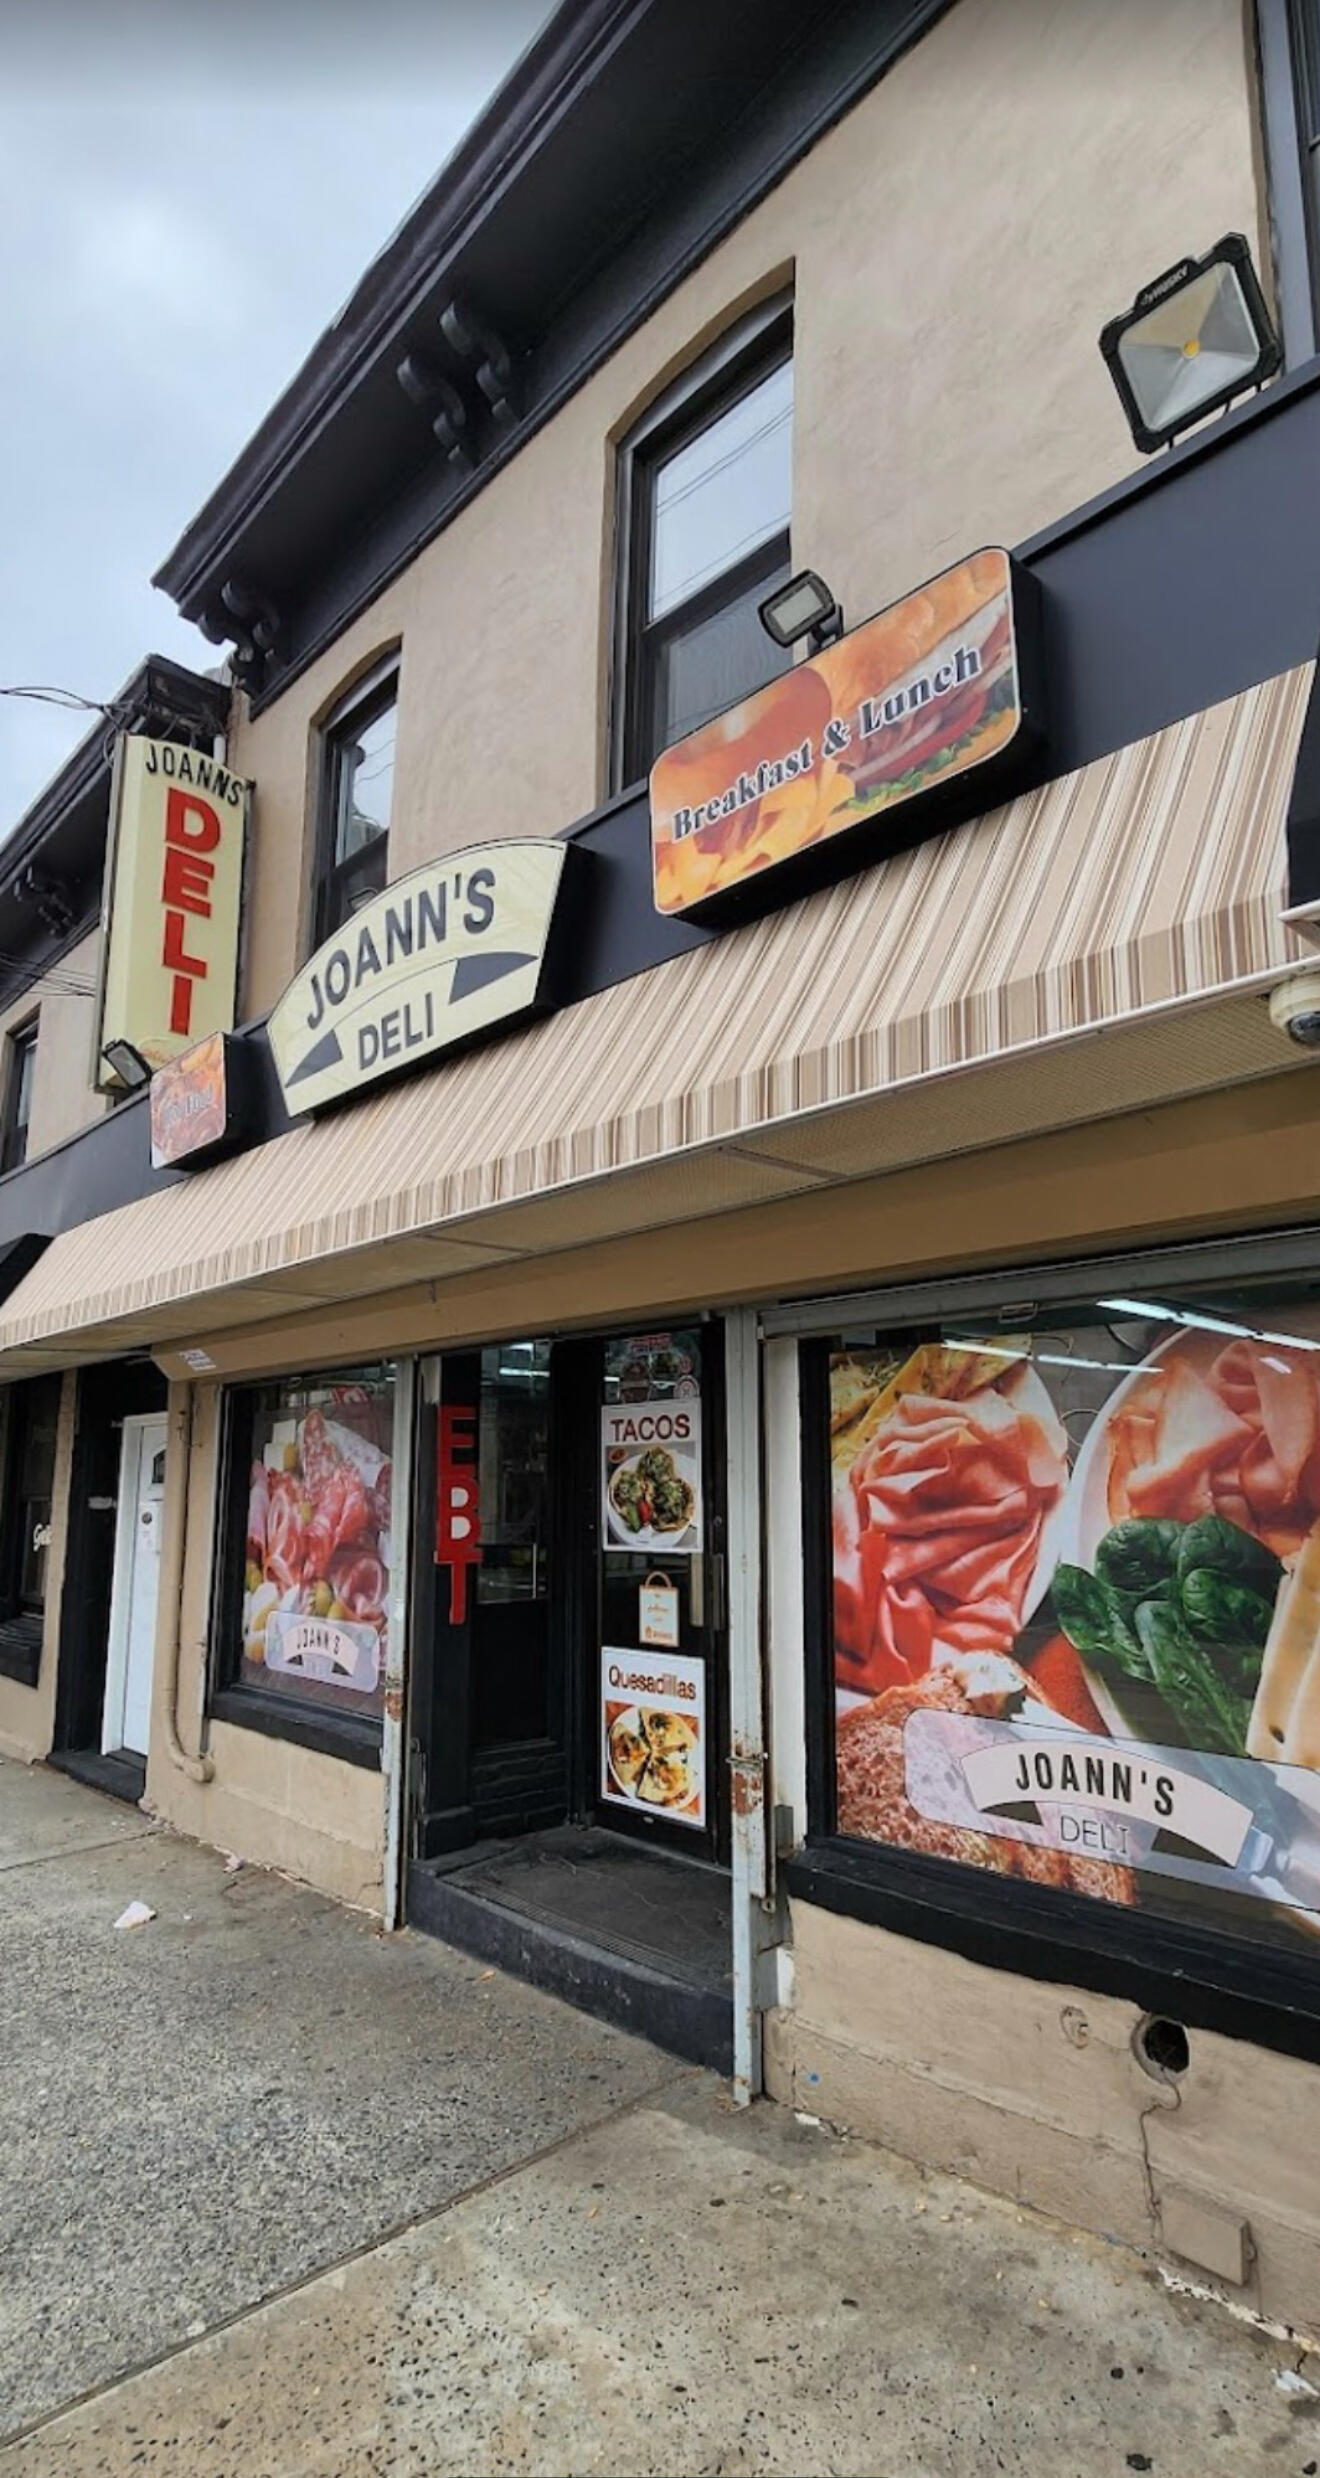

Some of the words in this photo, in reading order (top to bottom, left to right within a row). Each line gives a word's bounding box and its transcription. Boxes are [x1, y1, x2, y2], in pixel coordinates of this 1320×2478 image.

[146, 743, 243, 806] JOANNS
[673, 739, 813, 843] Breakfast
[821, 718, 850, 757] &
[859, 645, 980, 738] Lunch
[161, 787, 221, 1036] DELI
[307, 868, 496, 1030] JOANN'S
[358, 992, 434, 1071] DELI
[610, 1413, 690, 1442] TACOS
[433, 1405, 483, 1625] EBT
[296, 1627, 341, 1656] JOANNS
[608, 1665, 697, 1700] Quesadillas
[1016, 1752, 1174, 1816] JOANN'S
[1060, 1815, 1129, 1854] DELI
